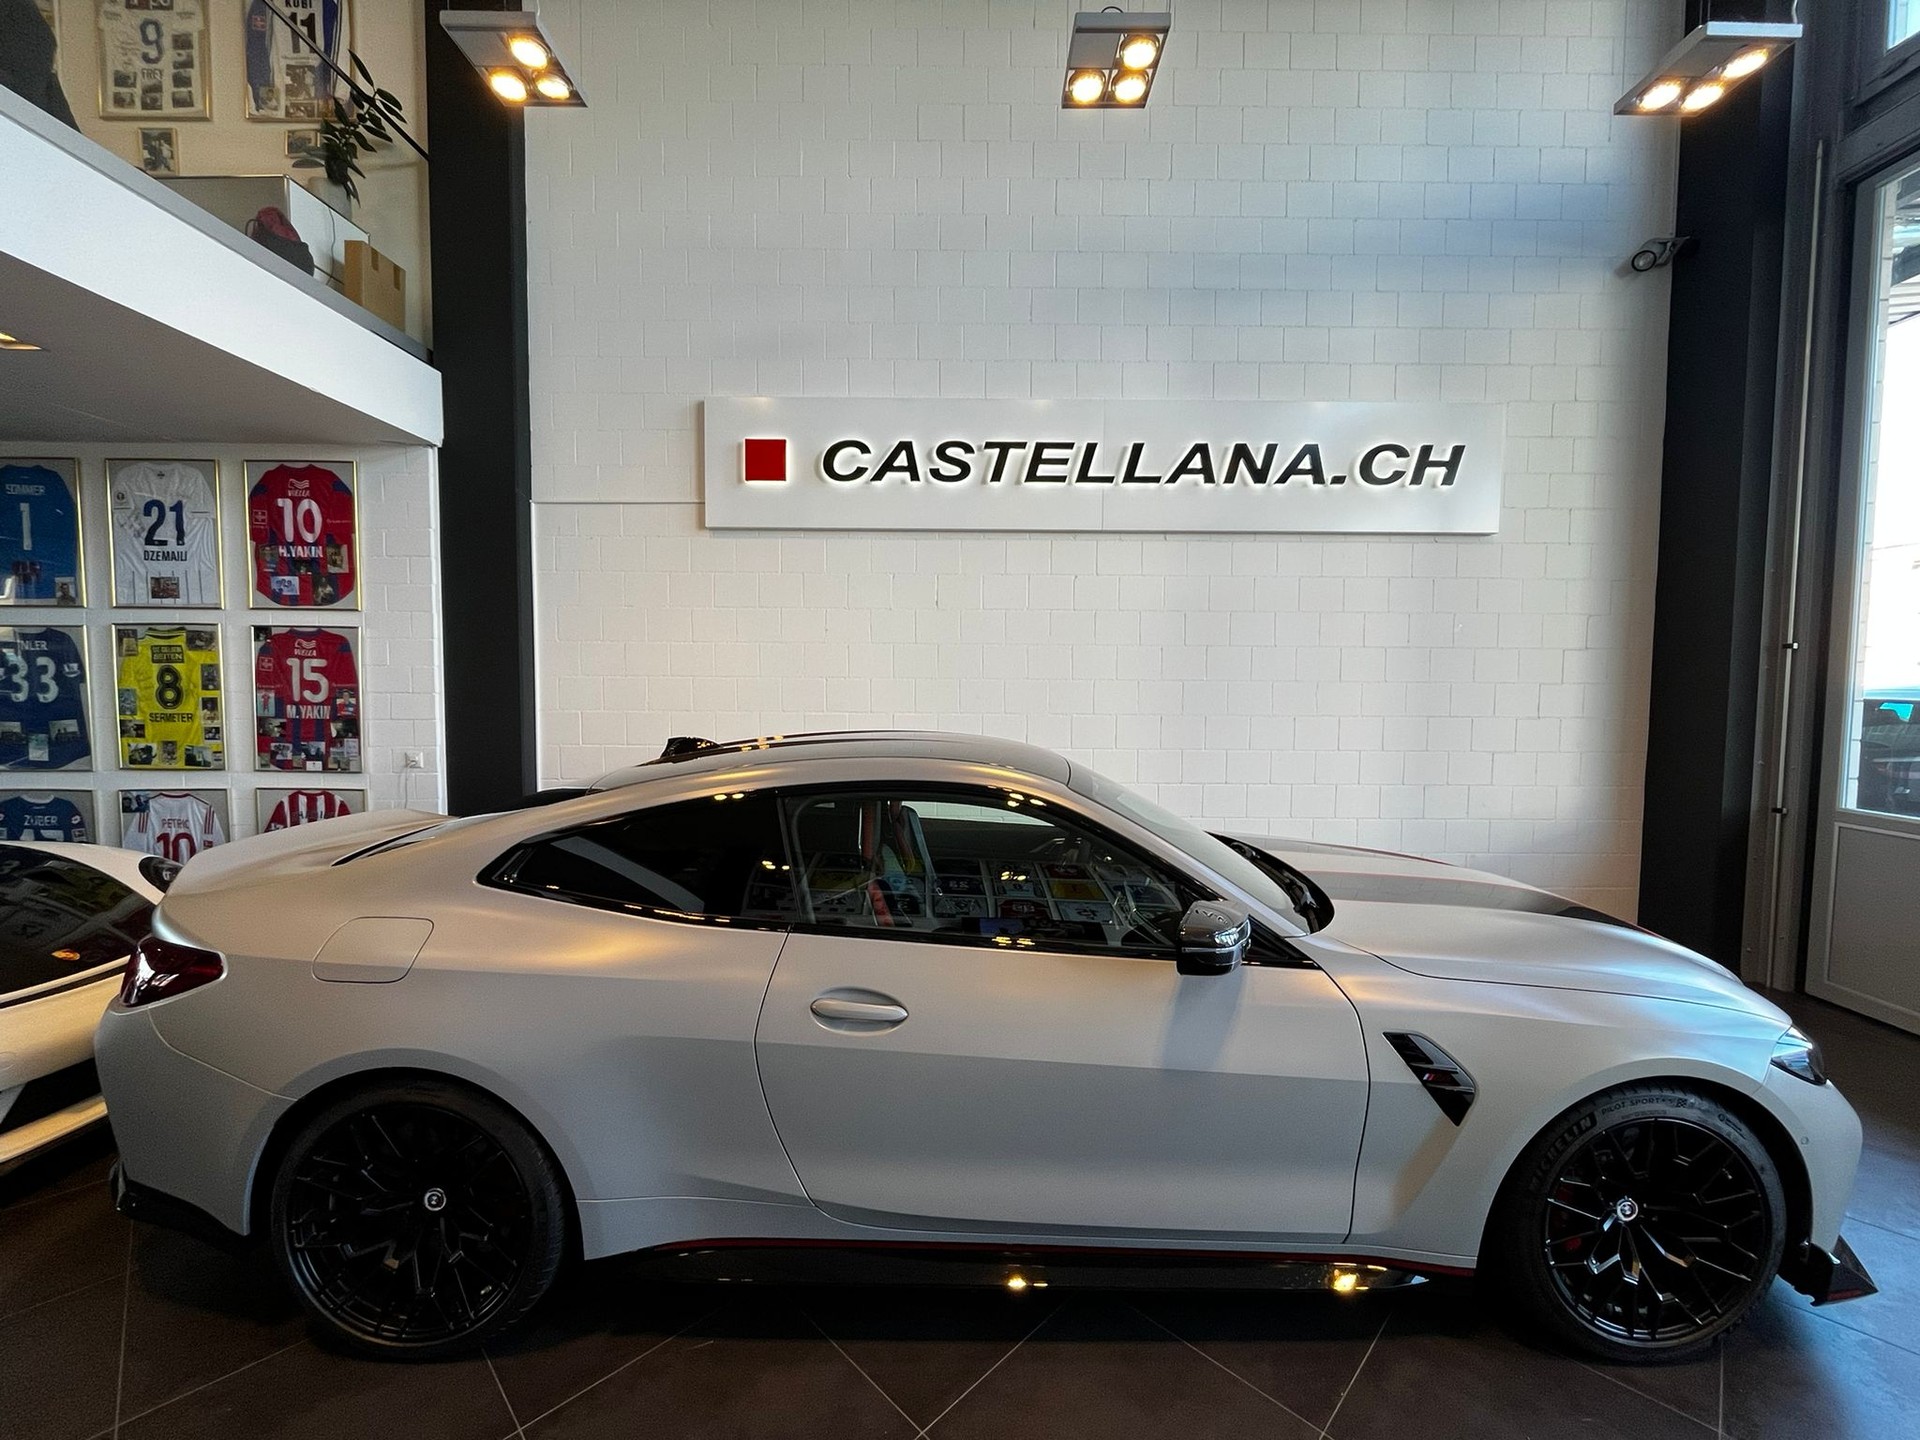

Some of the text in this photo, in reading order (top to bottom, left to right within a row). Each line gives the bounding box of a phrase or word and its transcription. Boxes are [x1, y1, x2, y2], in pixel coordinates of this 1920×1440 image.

[140, 18, 164, 64] 9
[289, 12, 316, 54] 11
[823, 440, 1466, 486] CASTELLANA.CH
[5, 484, 46, 496] SOMMER
[20, 502, 33, 551] 1
[143, 499, 186, 546] 21
[277, 498, 323, 543] 10
[144, 550, 188, 562] DZEMAILI
[8, 652, 59, 703] 33
[155, 664, 184, 710] 8
[286, 657, 330, 704] 15
[149, 712, 194, 723] SERMETER
[24, 814, 59, 827] ZUBER
[156, 832, 197, 863] 10
